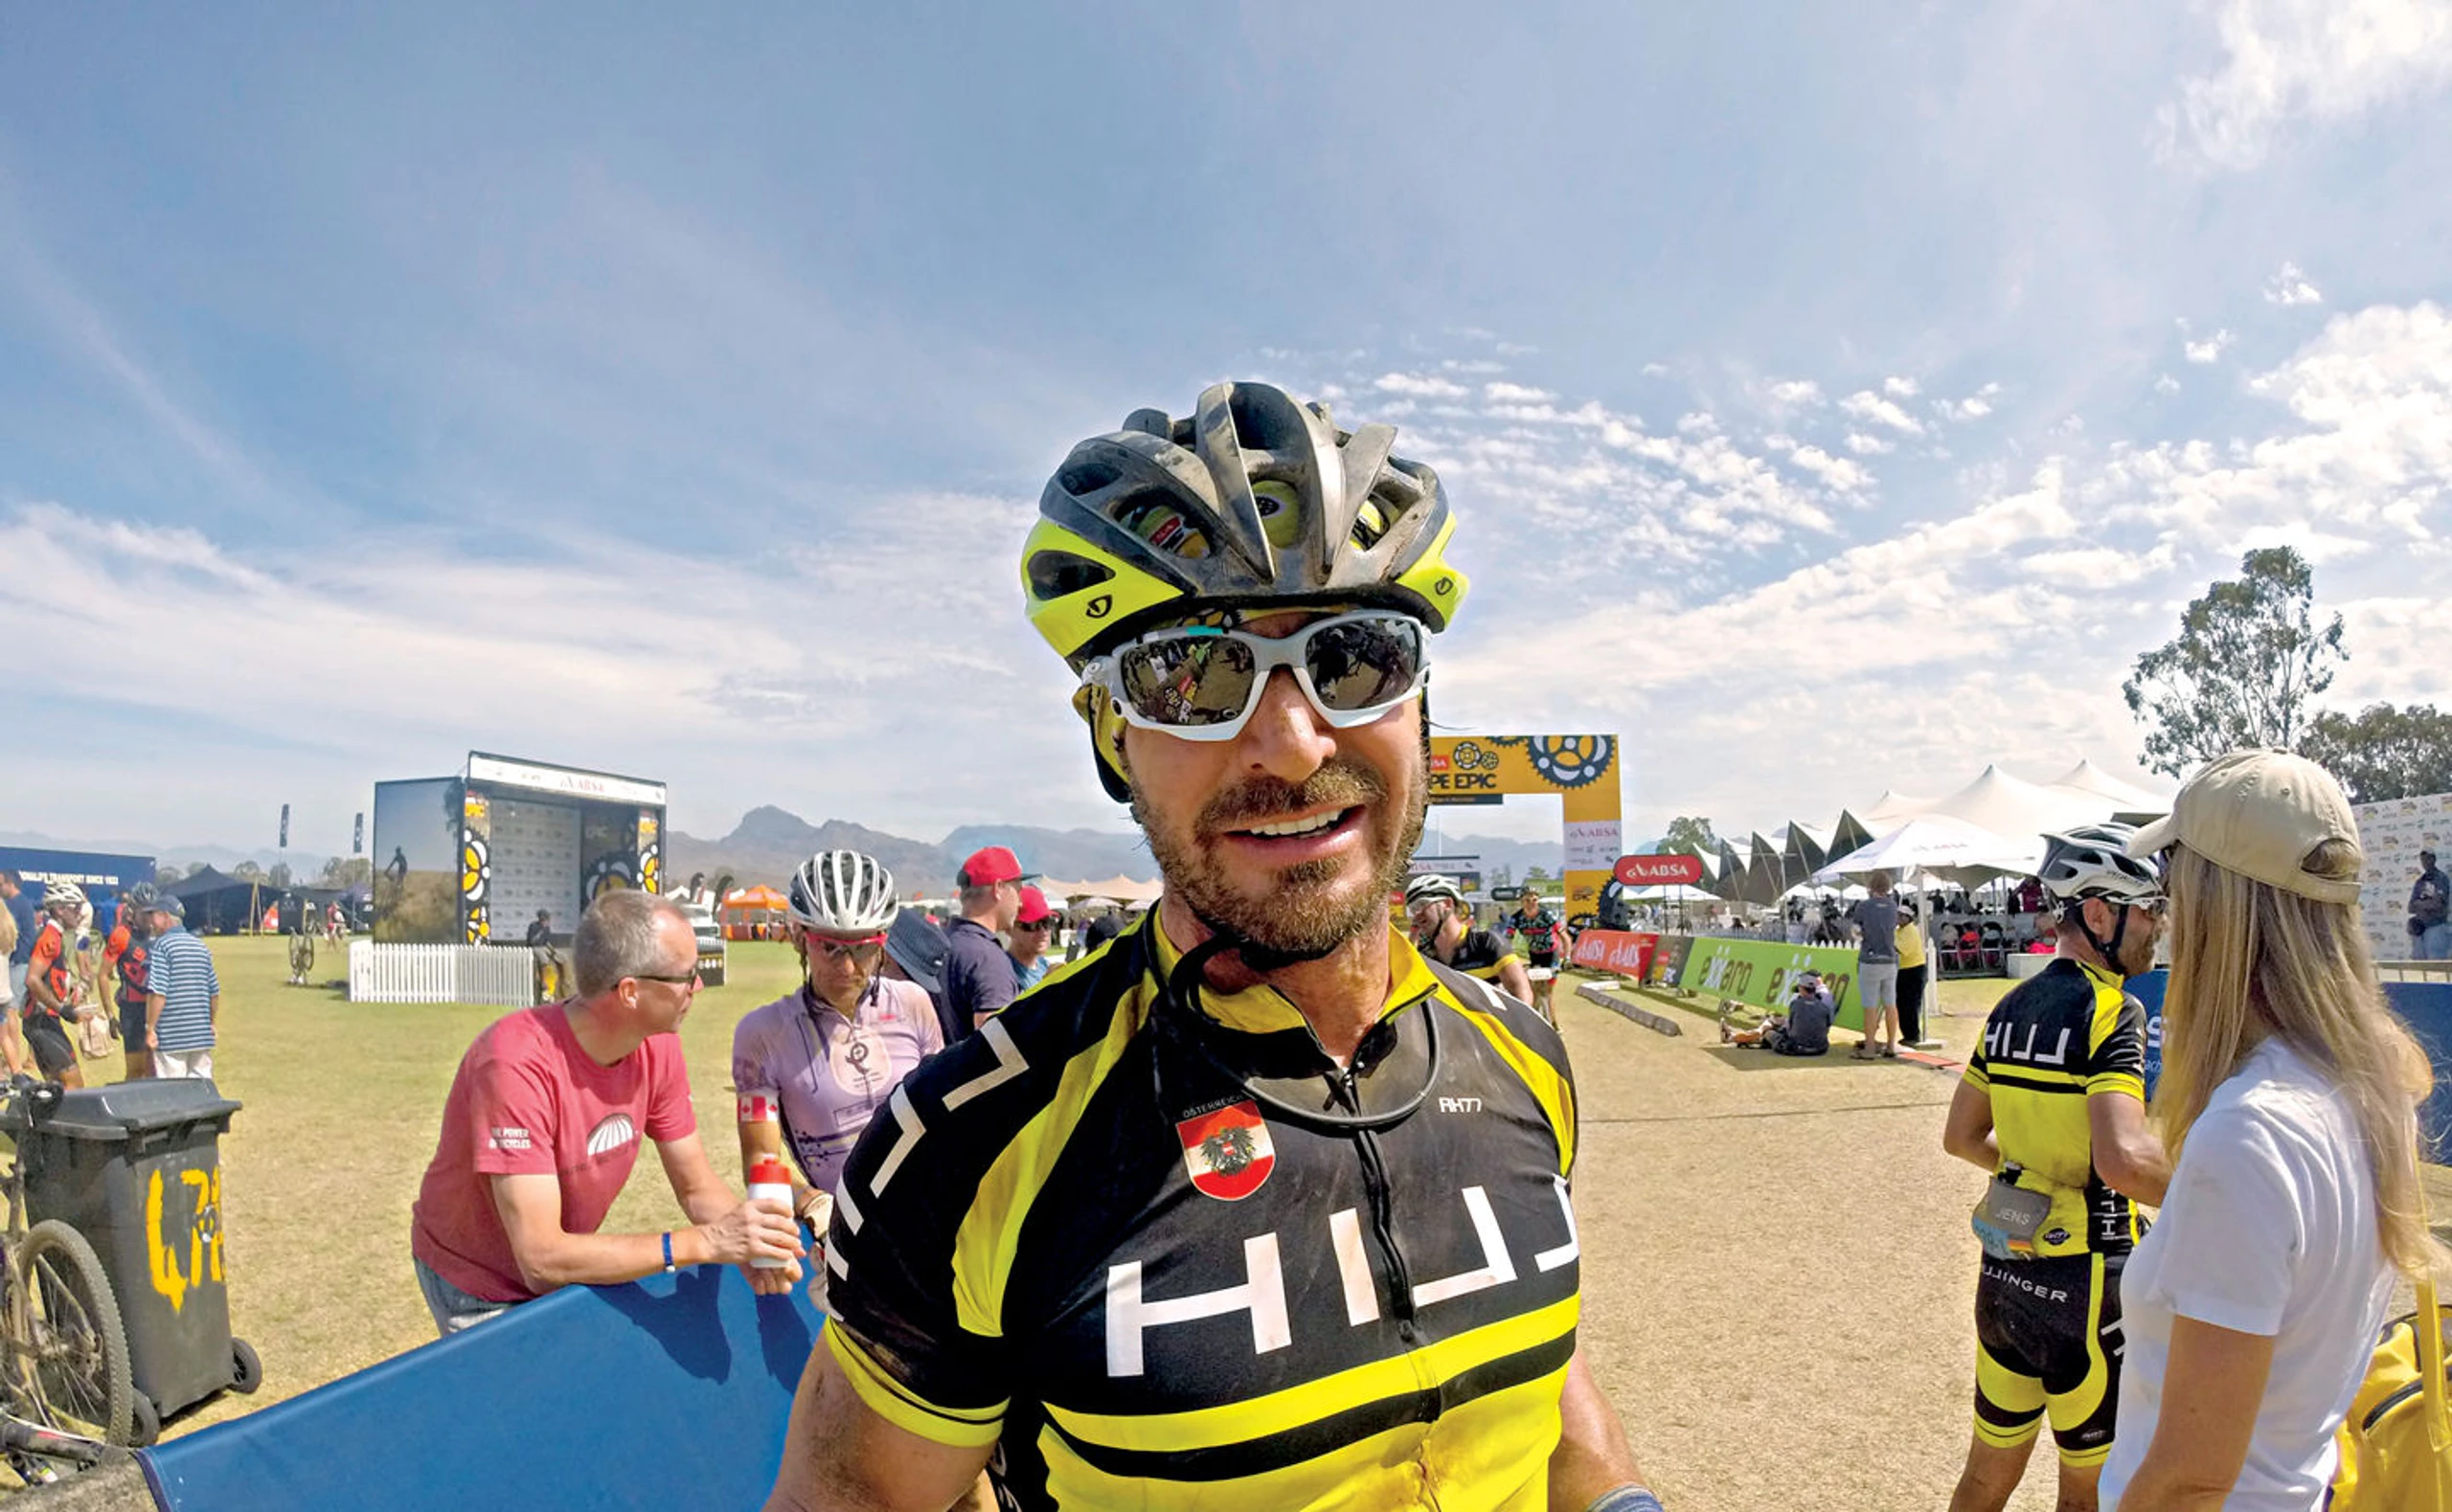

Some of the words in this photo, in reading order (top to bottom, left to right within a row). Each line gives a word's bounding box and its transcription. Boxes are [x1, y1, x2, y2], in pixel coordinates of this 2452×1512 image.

[1455, 774, 1496, 789] EPIC
[1647, 865, 1690, 877] ABSA
[1698, 946, 1753, 996] exxaro
